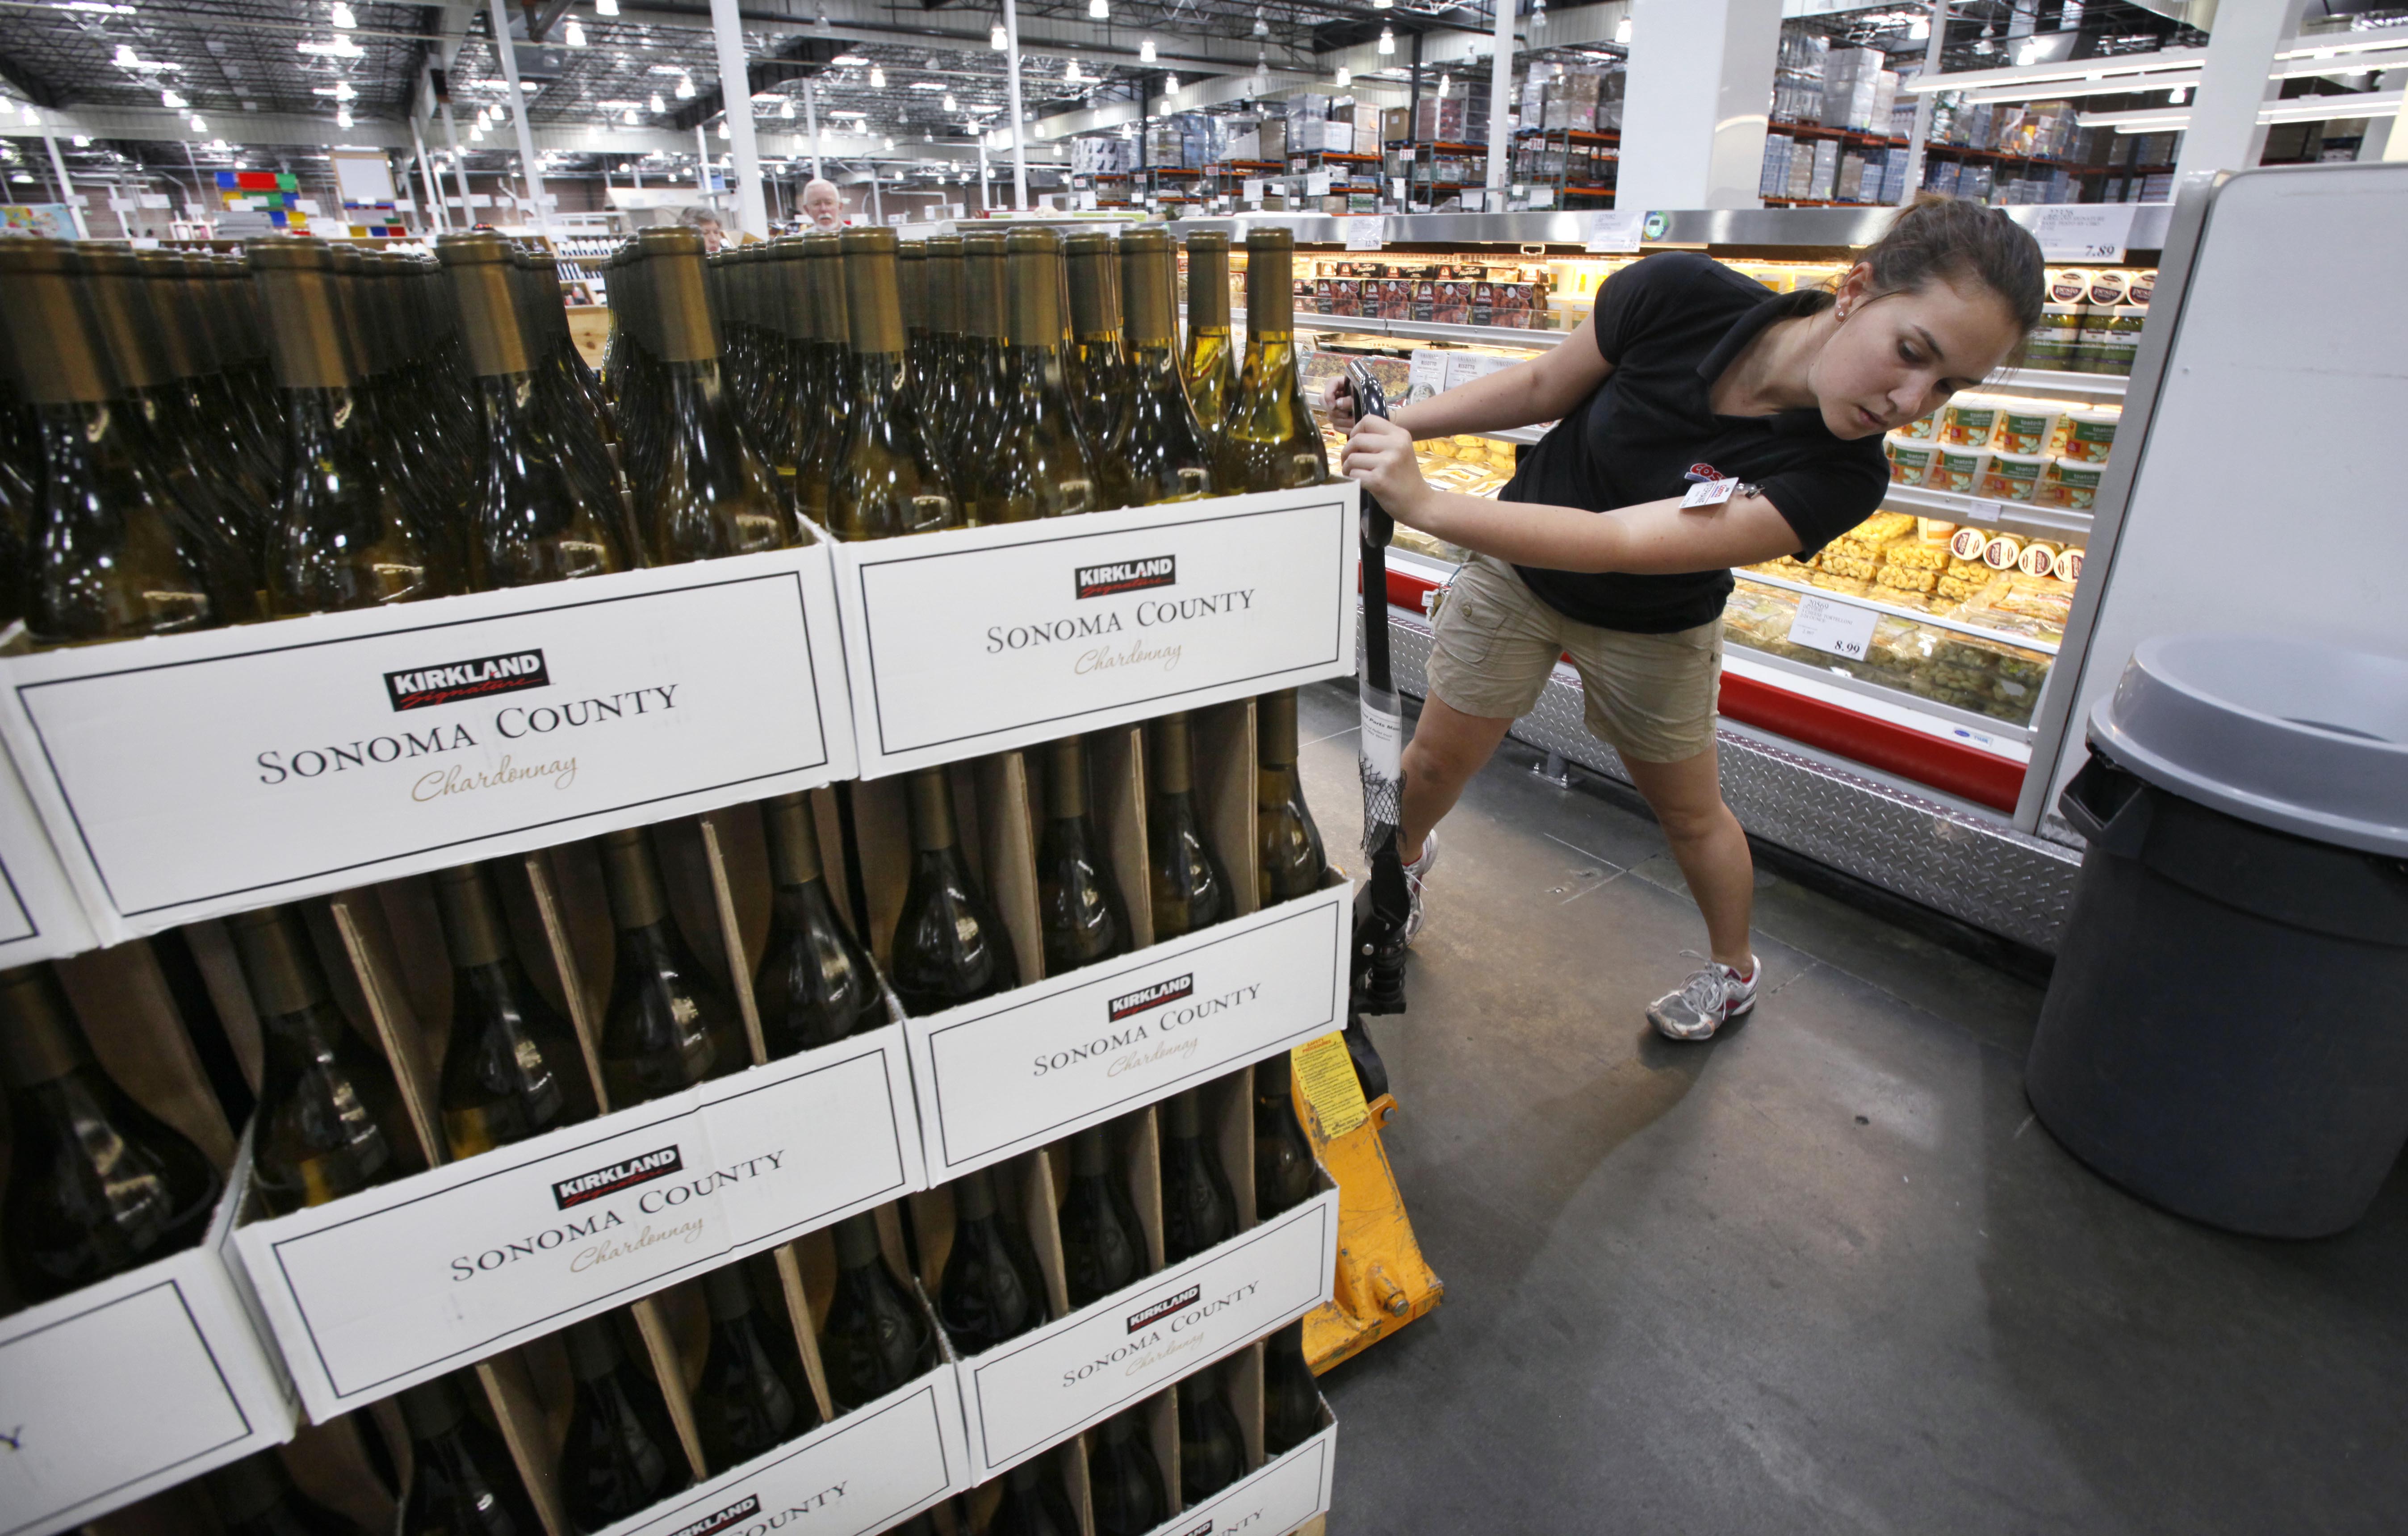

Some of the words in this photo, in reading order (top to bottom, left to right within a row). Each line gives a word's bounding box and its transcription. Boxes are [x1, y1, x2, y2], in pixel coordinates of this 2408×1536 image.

[1400, 150, 1415, 160] 312
[1530, 139, 1544, 149] 314
[2085, 245, 2115, 258] 7.89
[1690, 463, 1728, 481] COS
[1080, 558, 1173, 587] KIRKLAND
[986, 611, 1123, 654] SONOMA
[1136, 589, 1255, 627] COUNTY
[1074, 640, 1183, 675] Chardonnay
[1834, 640, 1860, 654] 8.99
[394, 653, 541, 695] KIRKLAND
[400, 677, 543, 711] Signature
[257, 723, 478, 785] SONOMA
[496, 684, 679, 739] COUNTY
[411, 754, 579, 802] Chardonnay
[1113, 976, 1191, 1013] KIRKLAND
[1034, 1026, 1149, 1077] SONOMA
[1160, 982, 1262, 1031] COUNTY
[1106, 1036, 1198, 1078] Chardonnay
[559, 1149, 677, 1198] KIRKLAND
[450, 1210, 625, 1282] SONOMA
[639, 1149, 786, 1214] COUNTY
[570, 1216, 704, 1273] Chardonnay
[1130, 1287, 1198, 1327] KIRKLAND
[1062, 1331, 1161, 1388] SONOMA
[1171, 1280, 1259, 1332] COUNTY
[1125, 1331, 1205, 1376] Chardonnay
